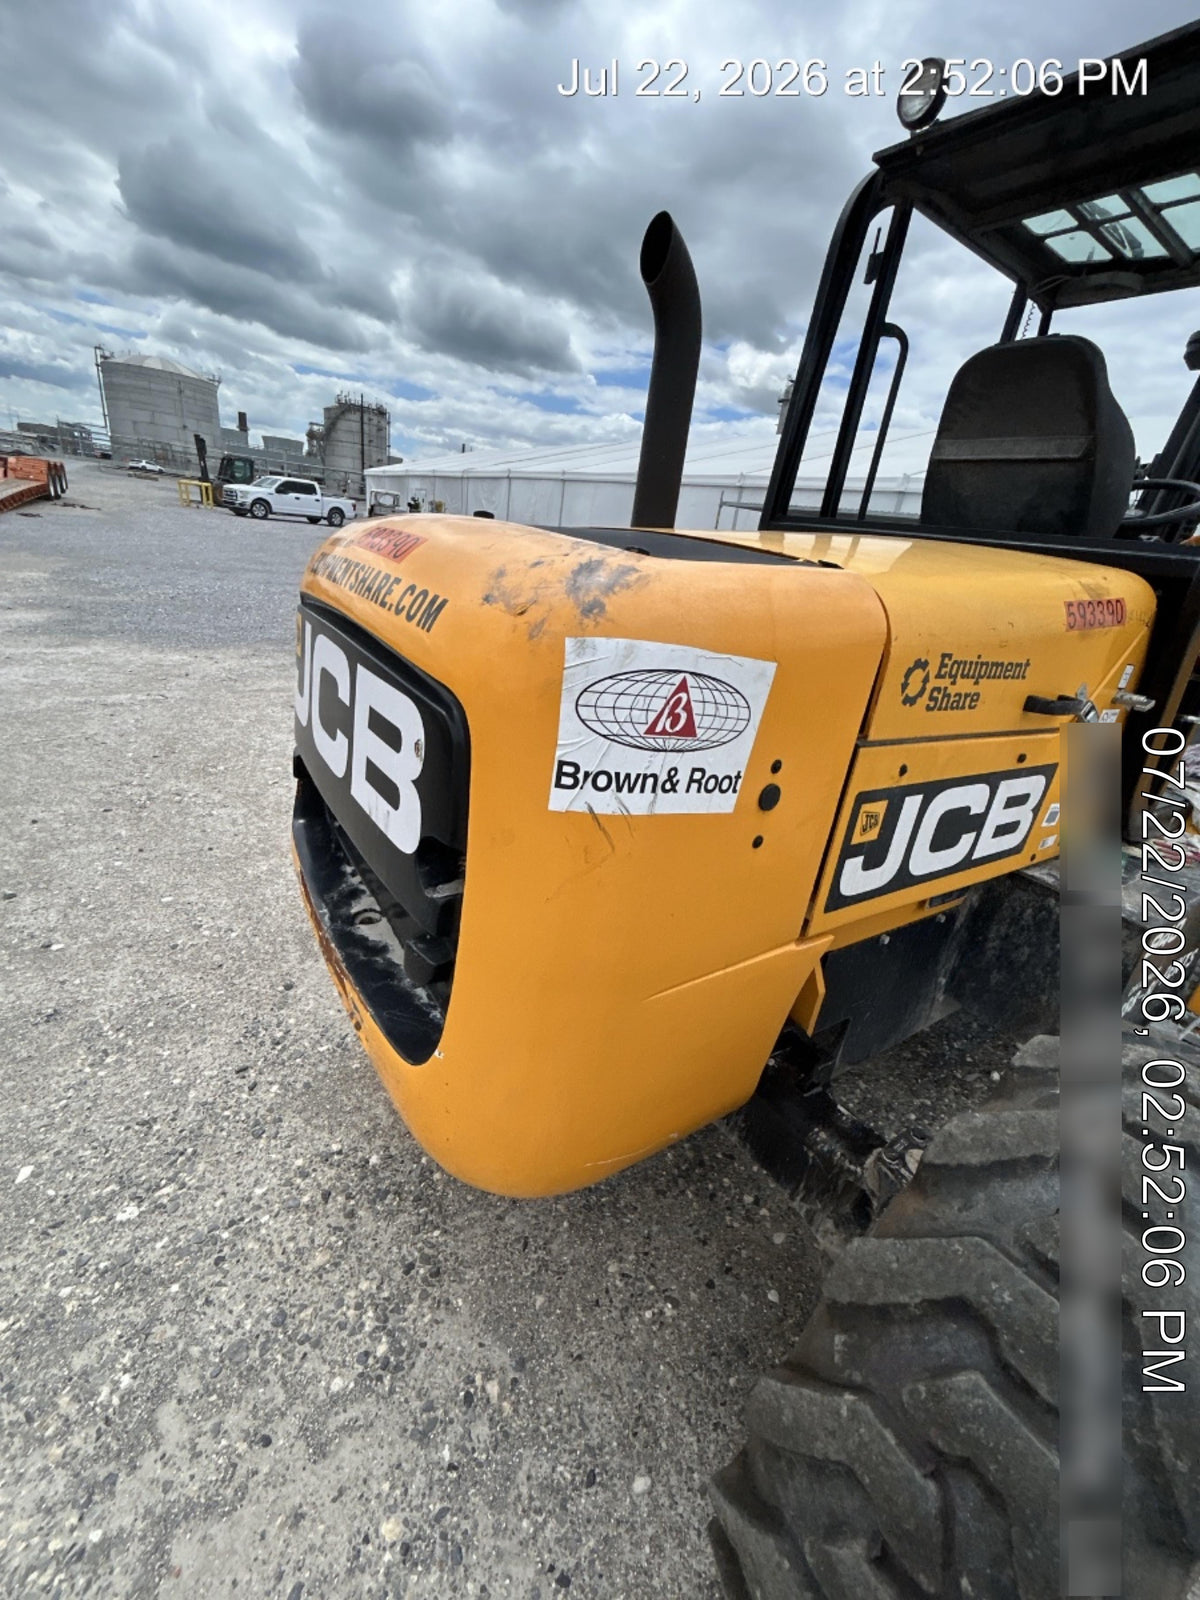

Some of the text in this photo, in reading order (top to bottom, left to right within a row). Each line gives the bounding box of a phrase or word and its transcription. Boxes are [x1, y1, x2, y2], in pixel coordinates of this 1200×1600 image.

[1067, 598, 1124, 630] 593390
[934, 653, 1031, 686] Equipment
[925, 686, 981, 712] Share
[294, 618, 426, 855] JCB
[554, 759, 659, 794] Brown
[685, 766, 742, 795] Root
[839, 774, 1047, 898] JCB
